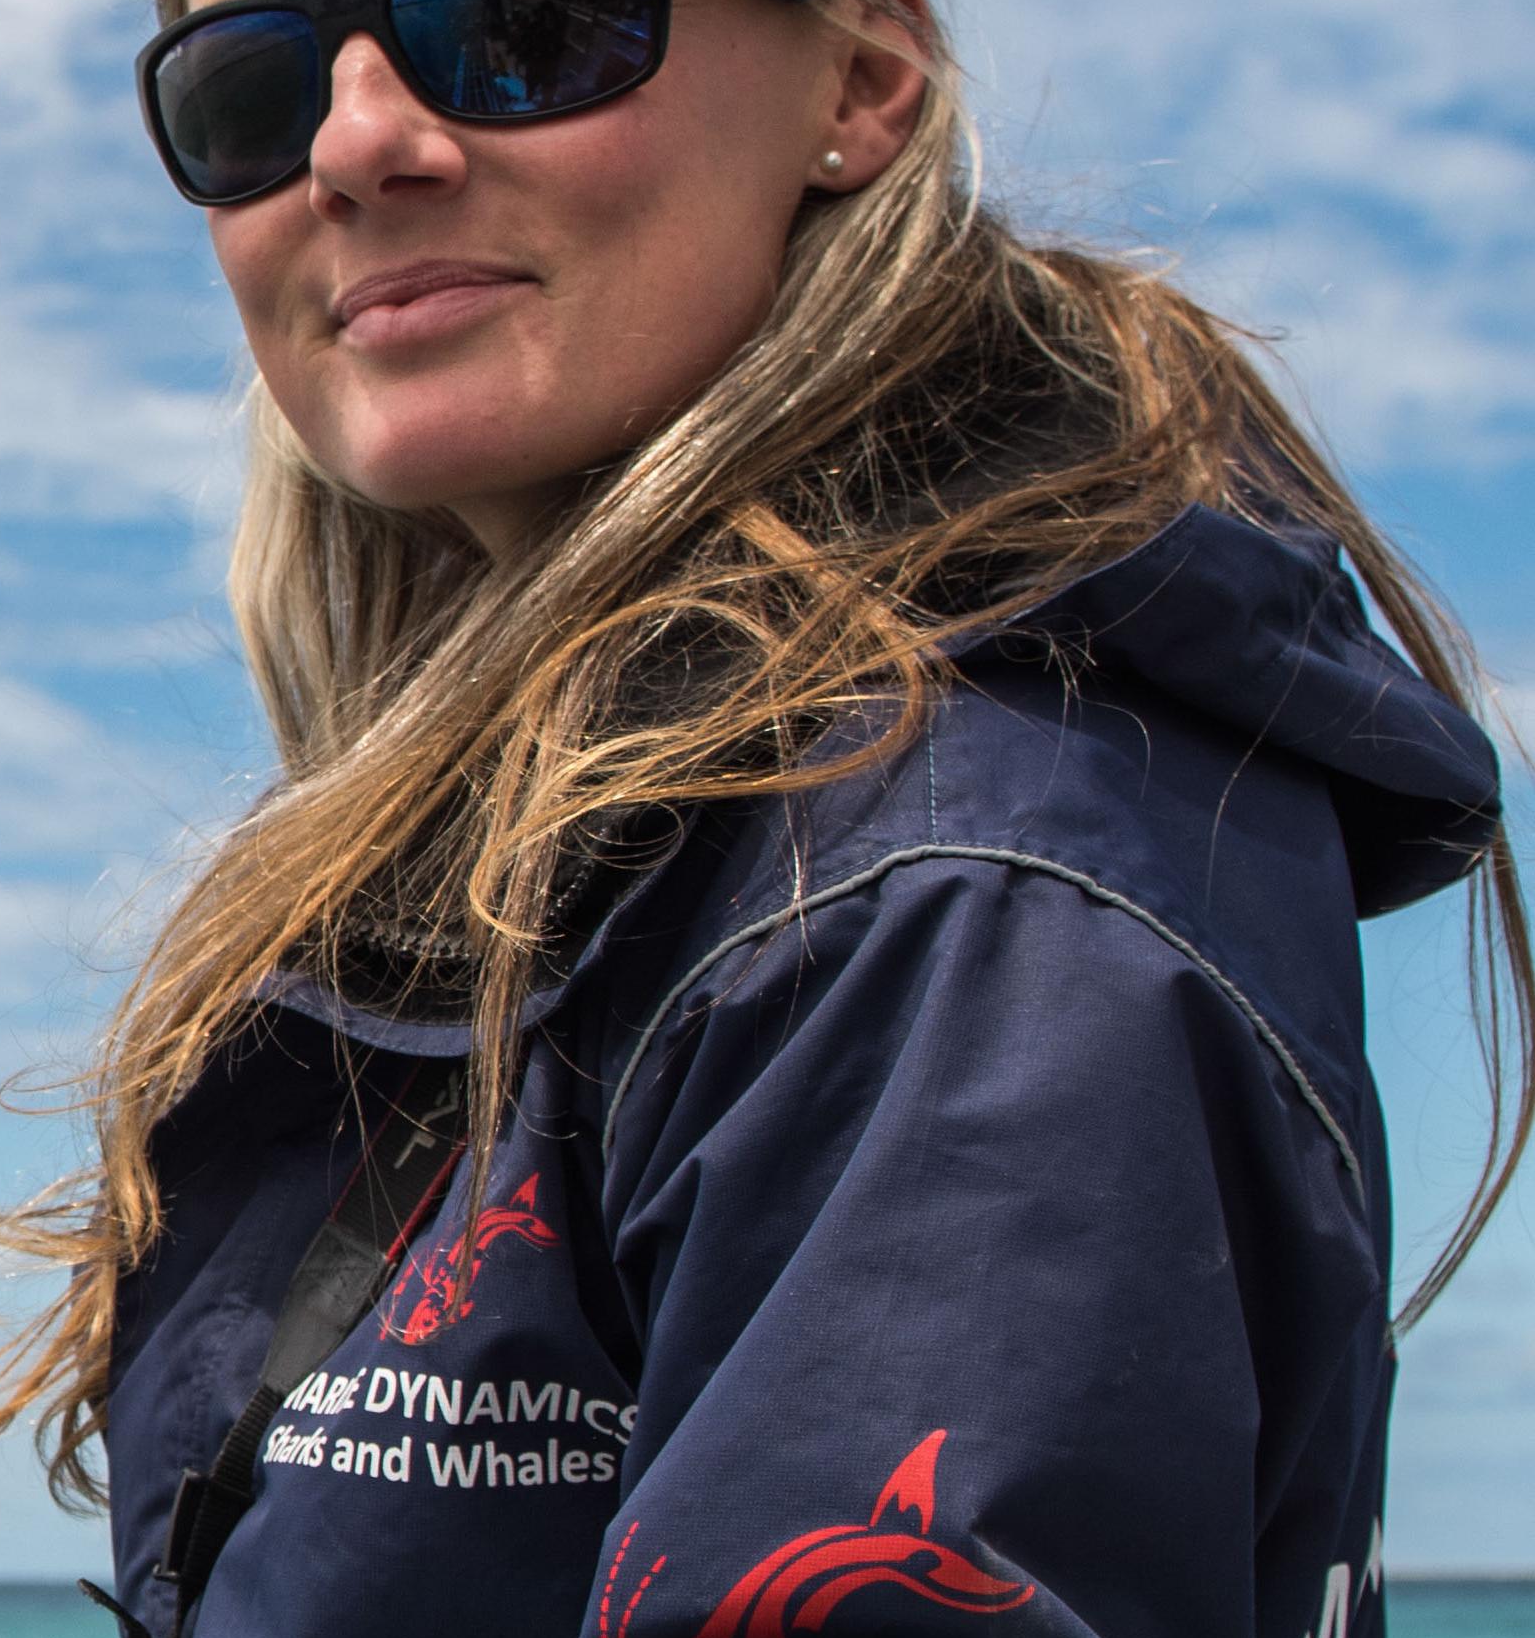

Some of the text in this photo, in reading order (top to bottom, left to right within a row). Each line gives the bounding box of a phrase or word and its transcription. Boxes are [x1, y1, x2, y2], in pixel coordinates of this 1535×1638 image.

[365, 1367, 639, 1446] DYNAMICS
[263, 1424, 615, 1488] Sharks and Whales
